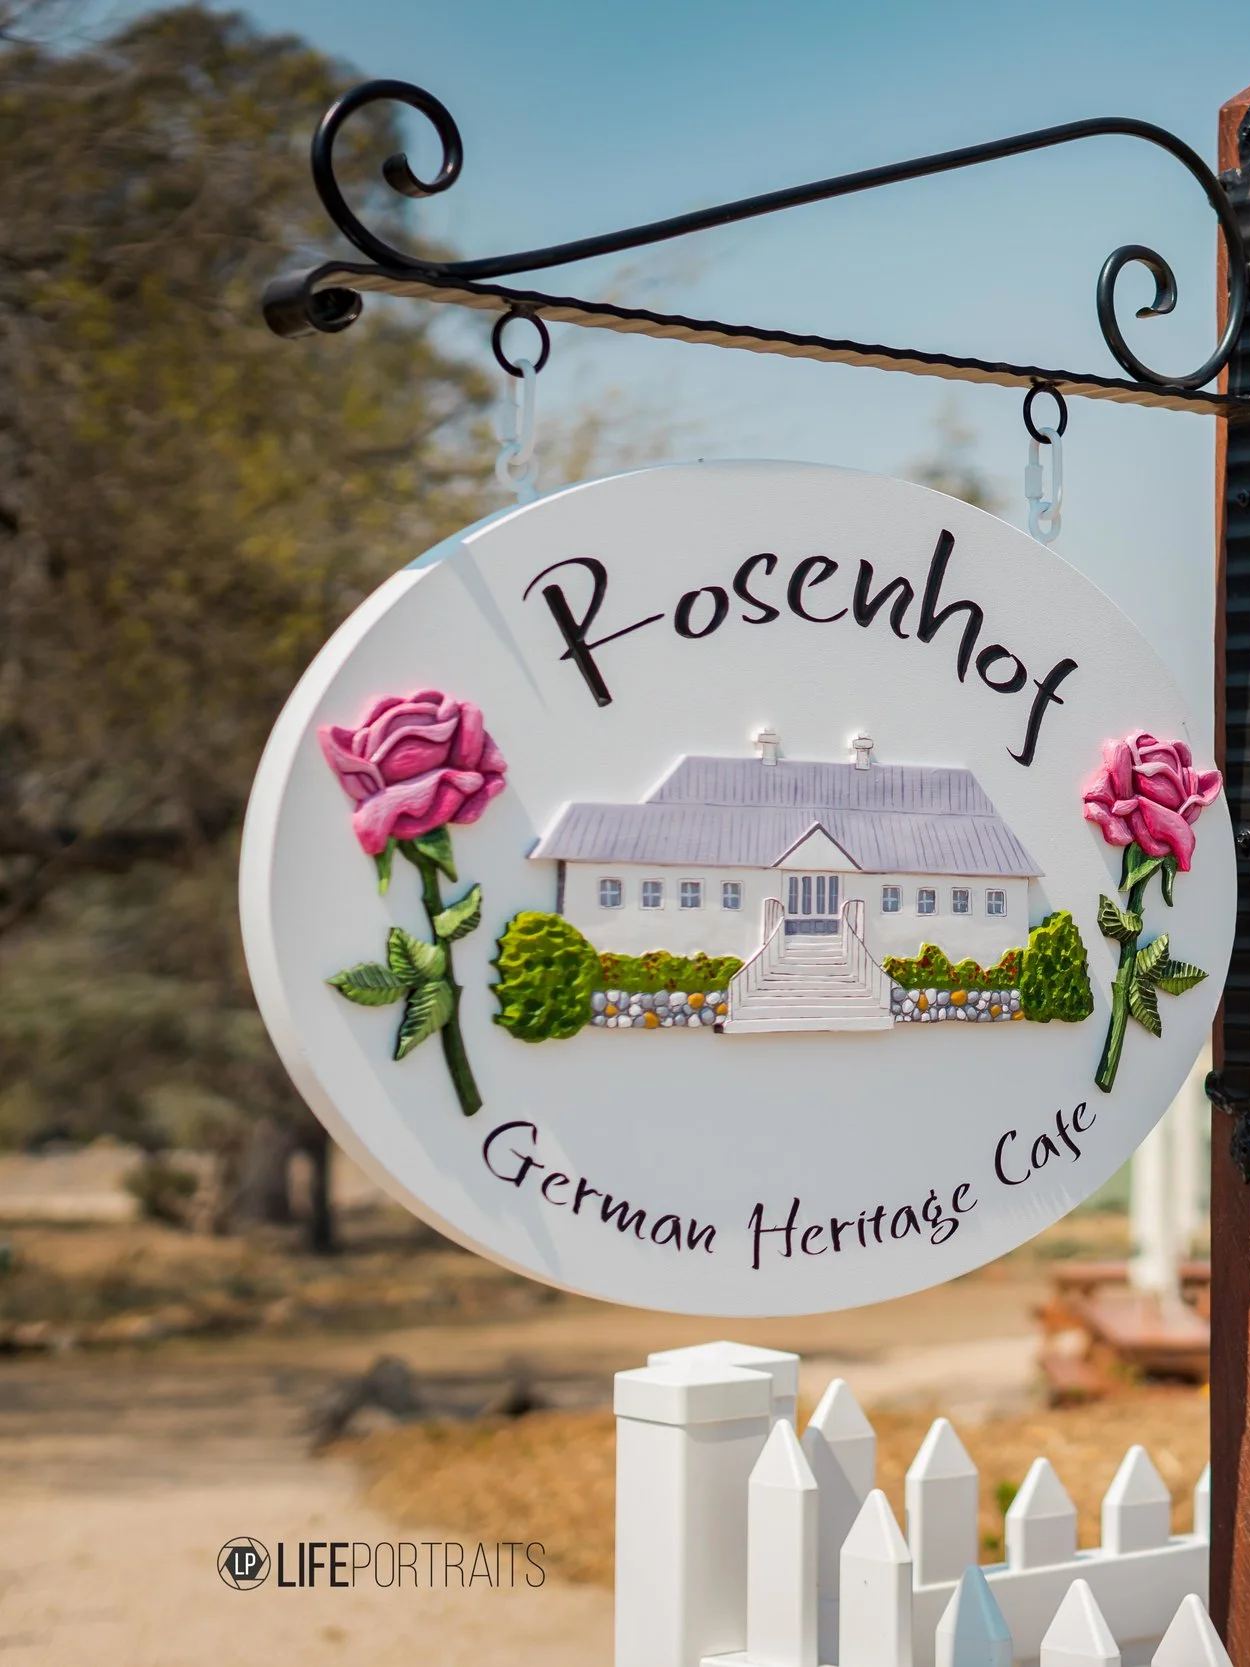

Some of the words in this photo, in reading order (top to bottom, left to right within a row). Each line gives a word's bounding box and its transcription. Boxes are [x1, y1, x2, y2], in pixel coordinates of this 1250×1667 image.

[523, 528, 1079, 767] Rosenhof
[483, 1120, 717, 1254] German
[747, 1182, 978, 1269] Heritage
[995, 1101, 1097, 1186] Cafe
